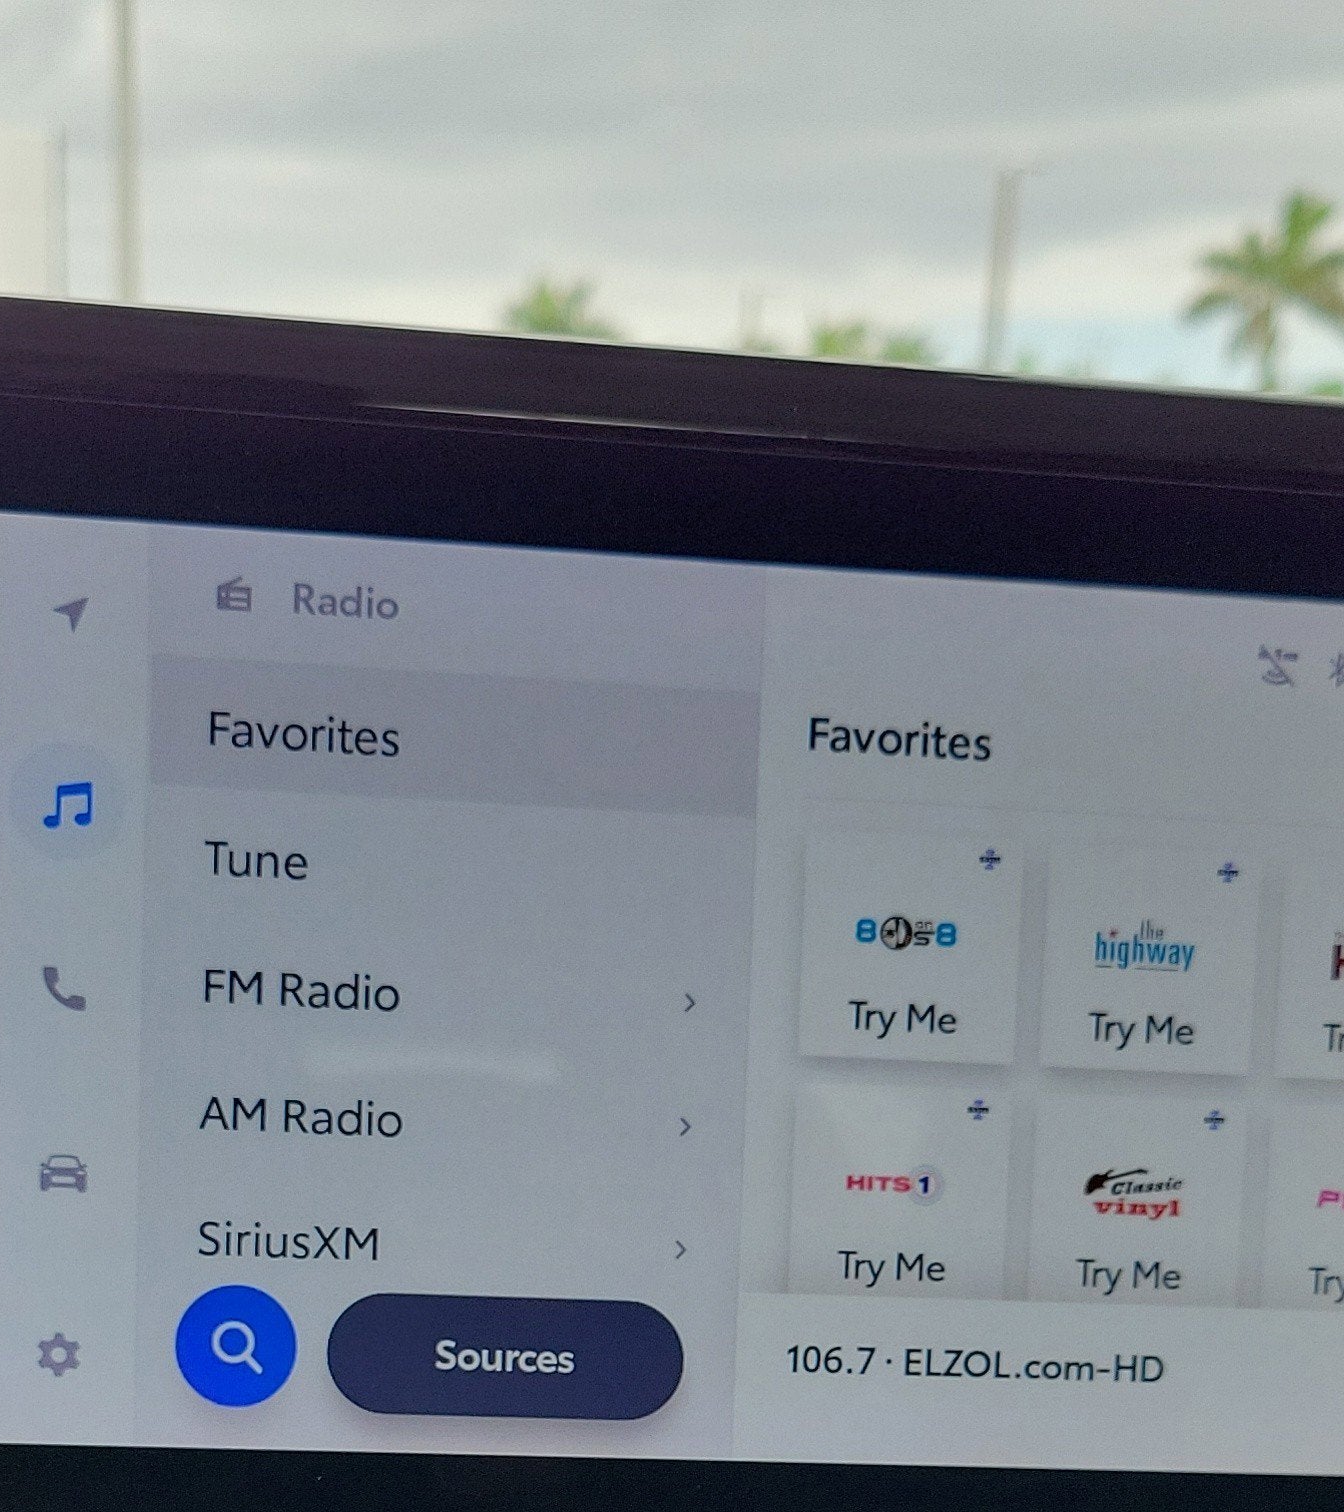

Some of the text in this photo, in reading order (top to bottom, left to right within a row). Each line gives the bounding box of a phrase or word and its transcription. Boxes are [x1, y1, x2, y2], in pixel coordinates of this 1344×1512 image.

[292, 582, 400, 621] Radio
[207, 711, 401, 759] Favorites
[807, 717, 993, 763] Favorites
[204, 840, 310, 882] Tune
[1095, 930, 1195, 972] highway
[202, 969, 401, 1014] FM Radio
[848, 1001, 958, 1040] Try Me
[1089, 1013, 1195, 1052] Try Me
[198, 1095, 404, 1139] AM Radio
[845, 1175, 911, 1192] HITS
[1111, 1177, 1183, 1196] Classic
[1093, 1198, 1180, 1221] vinyl
[197, 1220, 380, 1262] SiriusXM
[838, 1250, 946, 1286] Try Me
[1077, 1258, 1183, 1295] Try Me
[434, 1338, 576, 1376] Sources
[785, 1345, 1166, 1385] 106.7 ELZOL.com-HD
